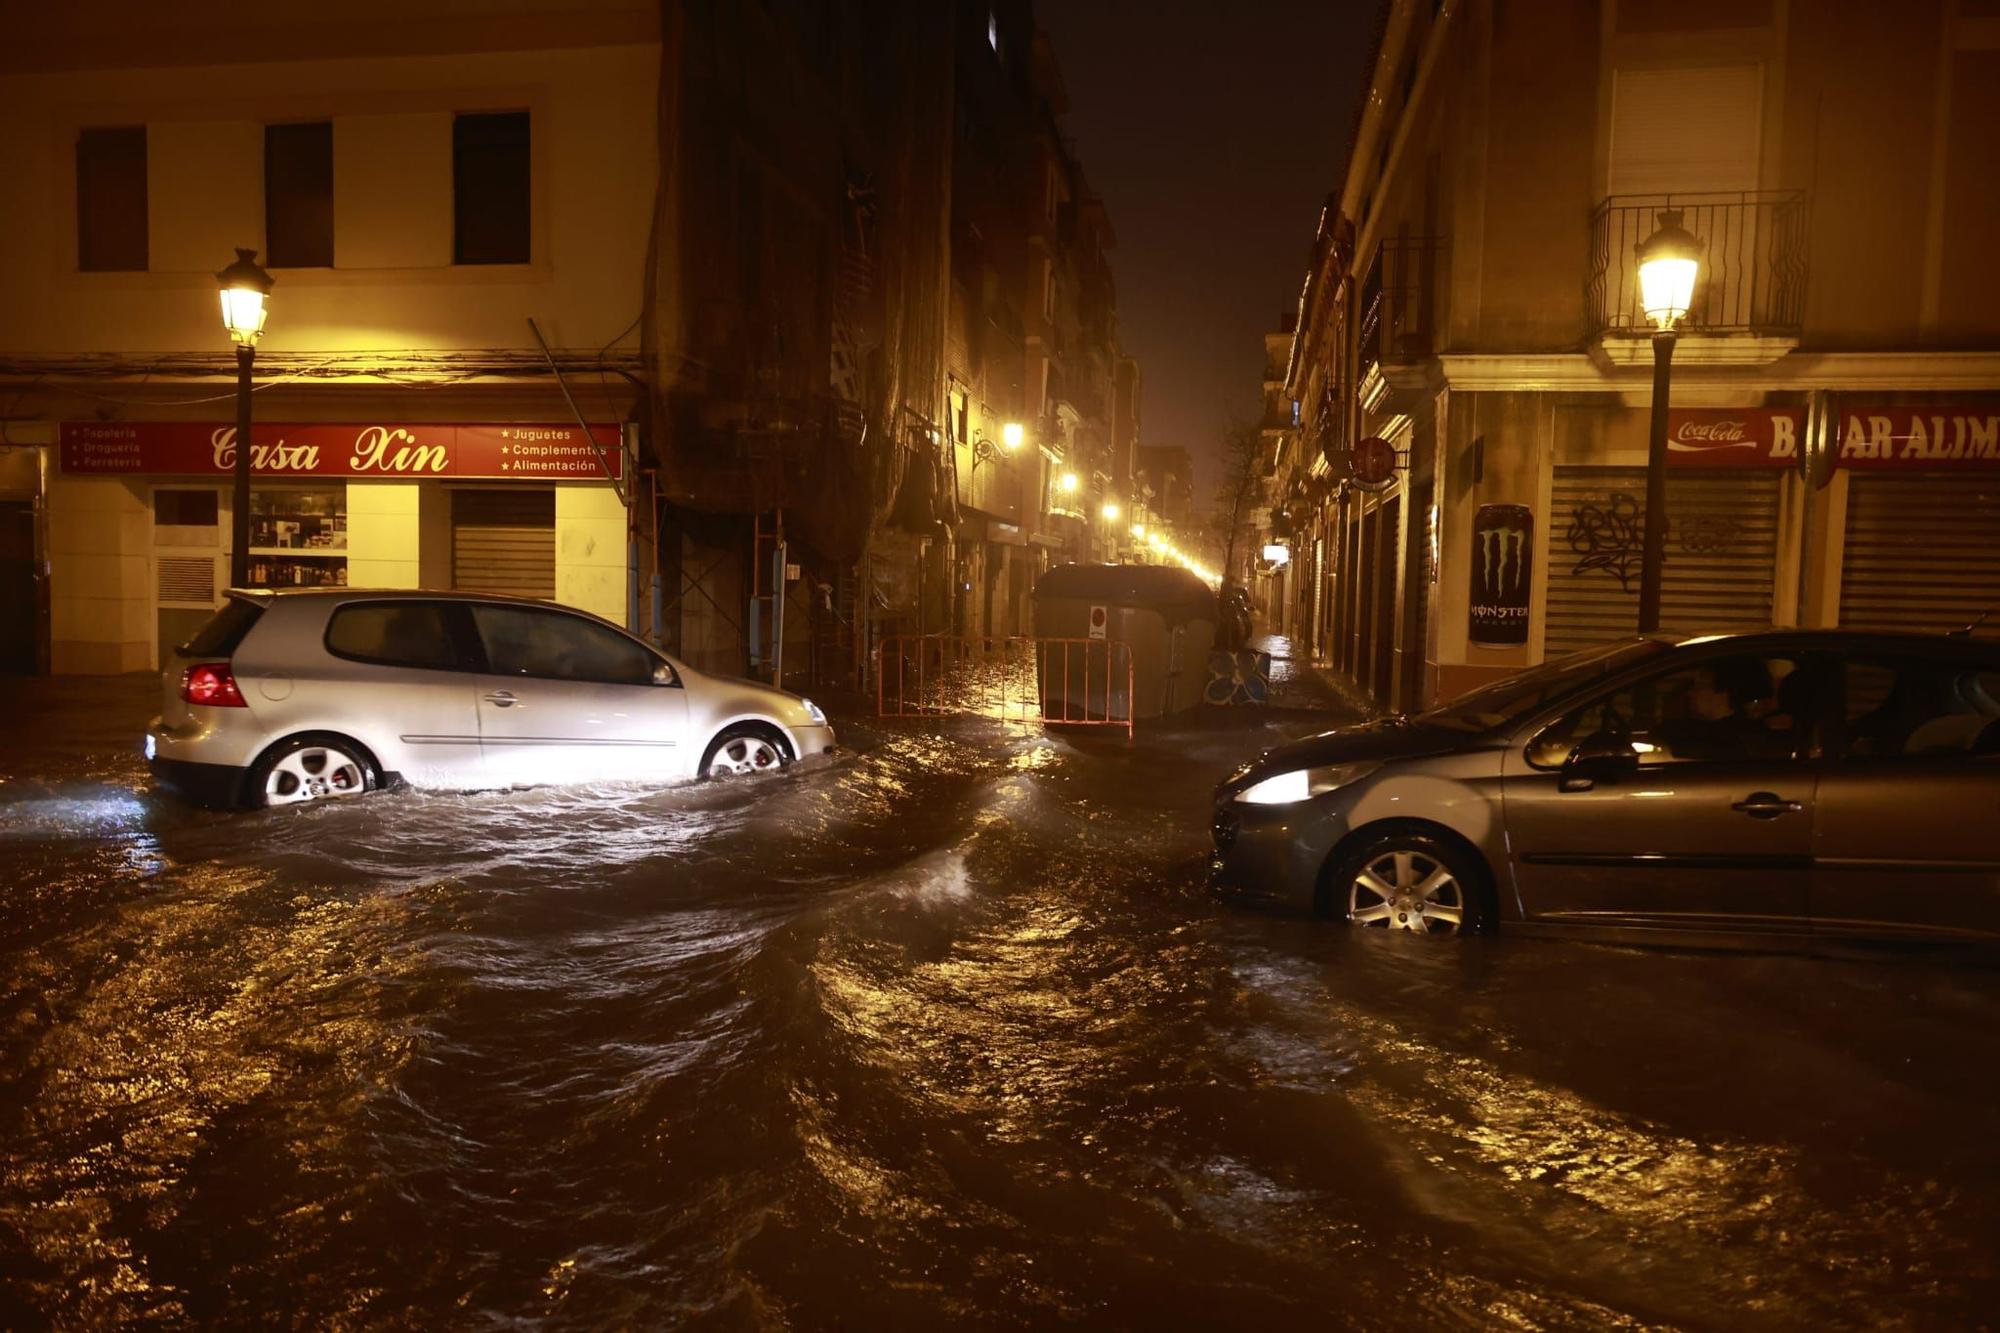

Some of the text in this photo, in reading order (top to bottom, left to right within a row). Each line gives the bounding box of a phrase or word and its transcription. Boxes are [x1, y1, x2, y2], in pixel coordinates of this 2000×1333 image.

[211, 426, 449, 472] Casa Xin
[513, 429, 571, 441] Juguetes
[1769, 415, 2000, 459] BAR ALIM
[513, 459, 596, 471] Alimentación
